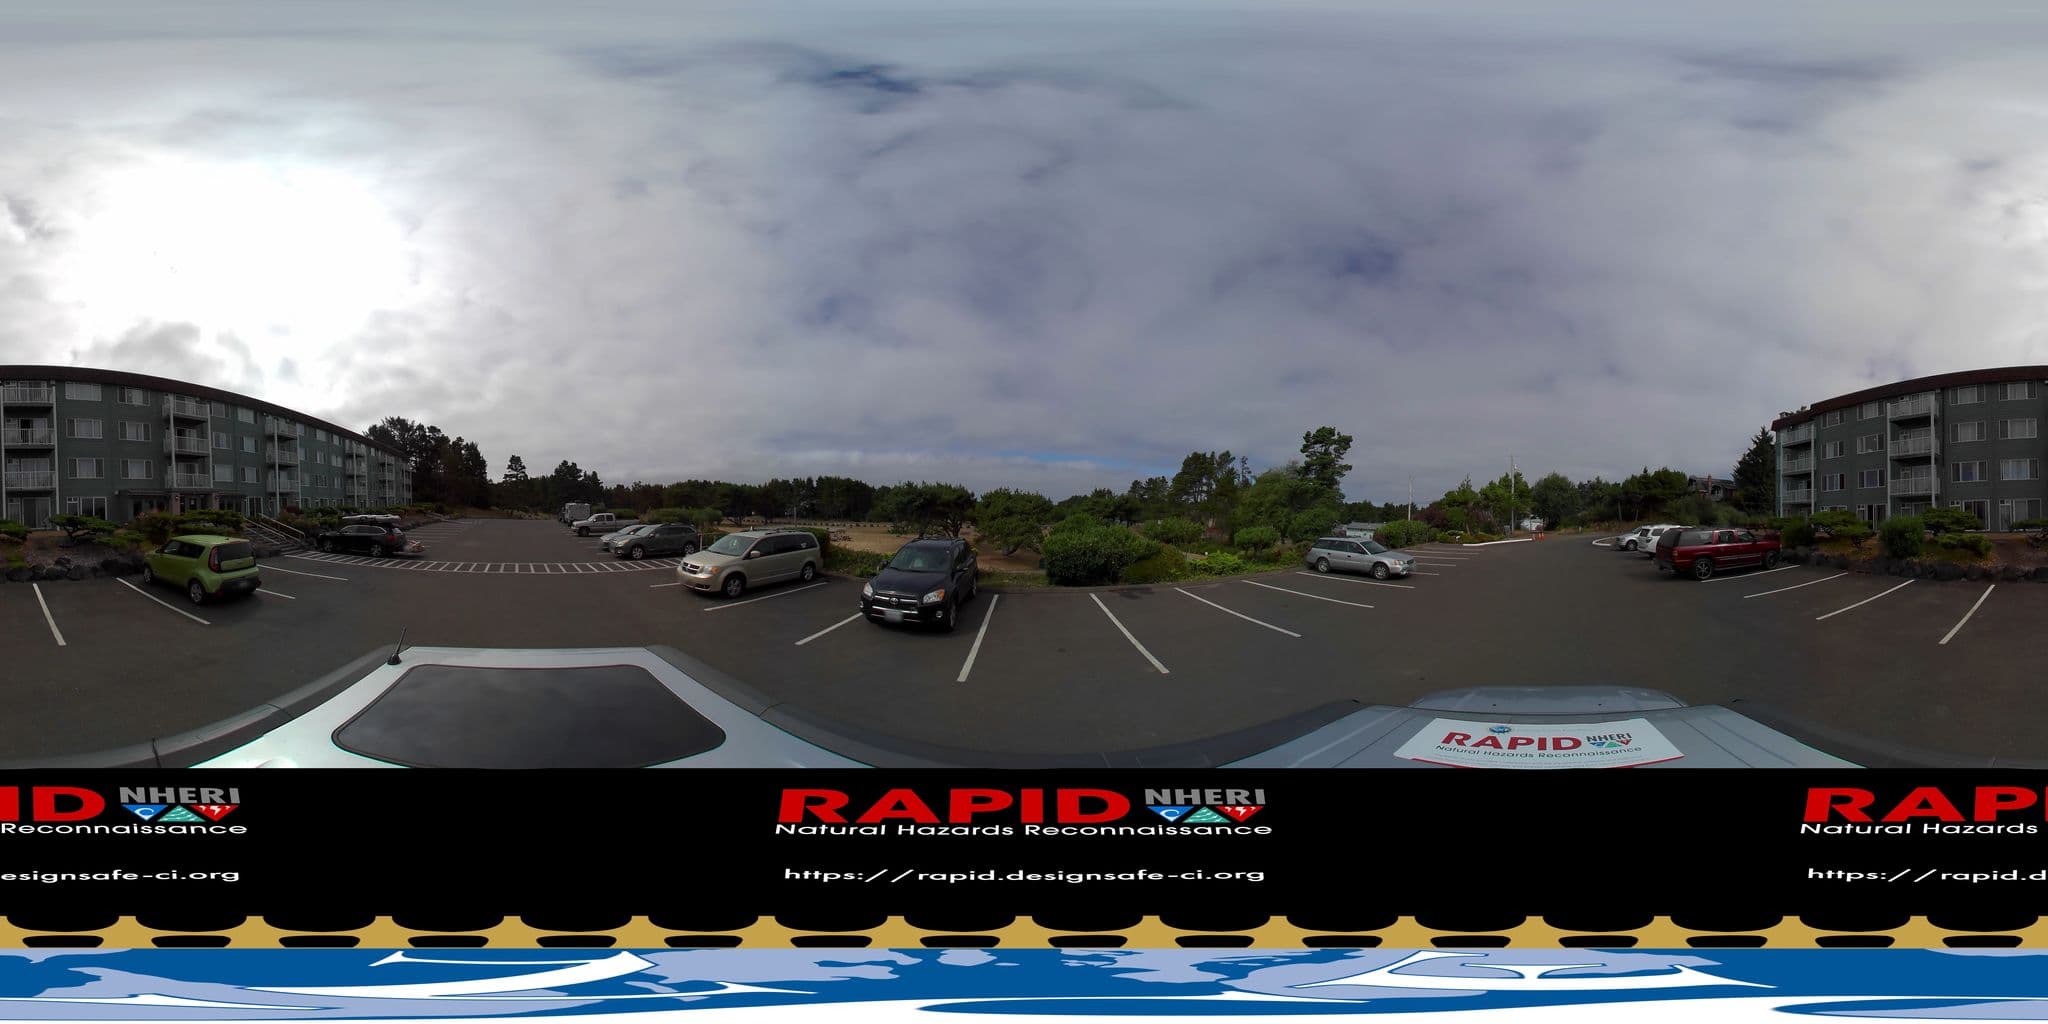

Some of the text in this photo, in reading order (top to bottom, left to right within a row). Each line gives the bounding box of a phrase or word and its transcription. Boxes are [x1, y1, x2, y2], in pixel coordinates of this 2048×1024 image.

[1441, 732, 1633, 751] RAPID NHERI
[1435, 745, 1642, 758] Natural Hazards Reconnaissance
